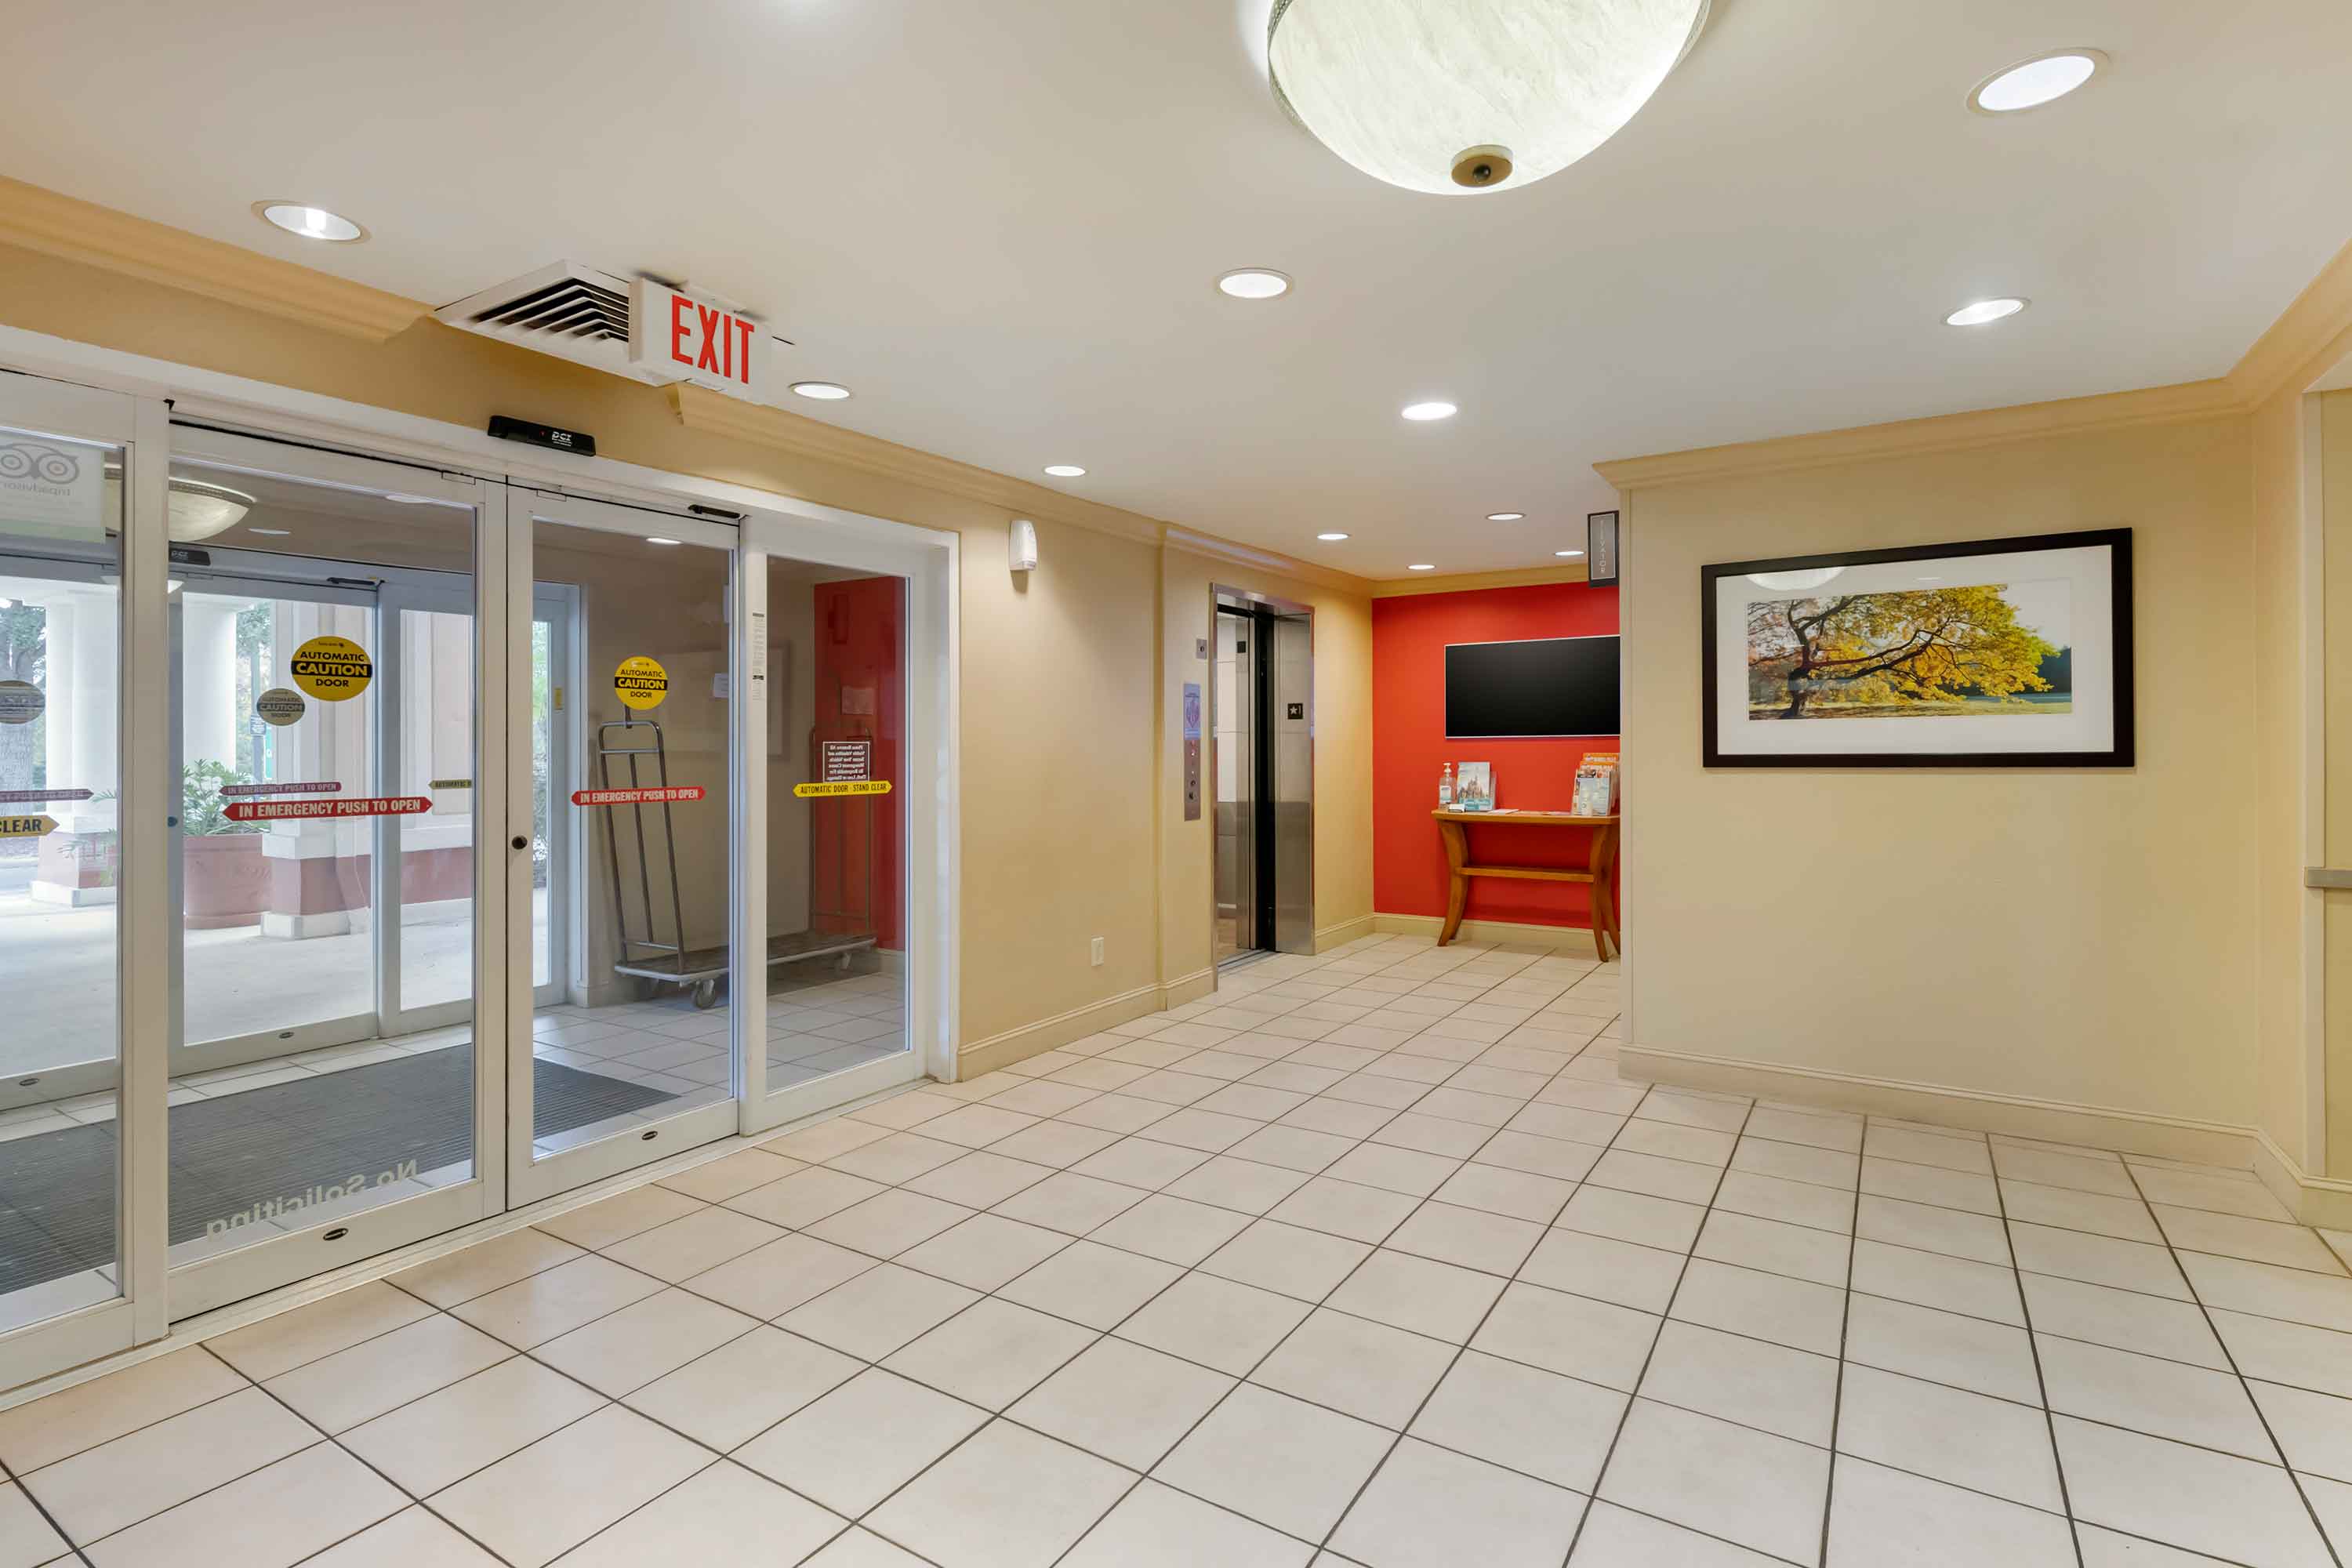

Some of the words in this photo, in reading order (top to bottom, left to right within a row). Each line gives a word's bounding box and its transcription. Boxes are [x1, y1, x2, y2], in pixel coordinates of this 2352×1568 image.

[672, 295, 754, 384] EXIT
[300, 652, 365, 662] AUTOMATIC
[296, 662, 367, 676] CAUTION
[618, 678, 665, 689] CAUTION
[580, 793, 590, 803] IN
[592, 791, 641, 802] EMERGENCY
[643, 790, 664, 800] PUSH
[666, 790, 677, 799] TO
[678, 789, 698, 799] OPEN
[239, 805, 253, 817] IN
[257, 802, 333, 815] EMERGENCY
[337, 800, 369, 814] PUSH
[372, 800, 387, 811] TO
[390, 799, 421, 811] OPEN
